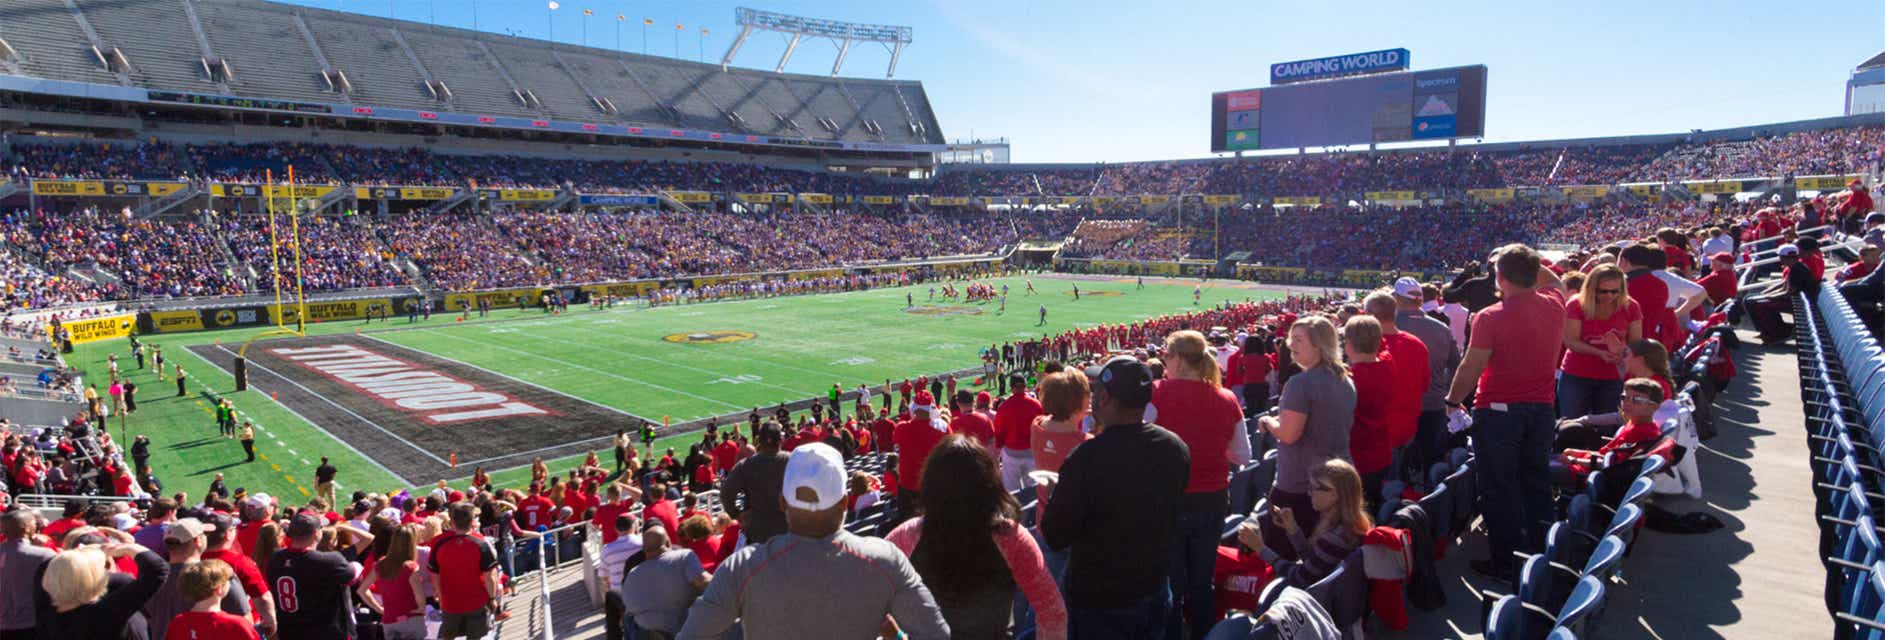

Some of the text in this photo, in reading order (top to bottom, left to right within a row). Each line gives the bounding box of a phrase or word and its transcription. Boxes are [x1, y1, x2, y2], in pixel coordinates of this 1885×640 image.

[1274, 51, 1399, 77] CAMPING WORLD
[73, 319, 116, 333] BUFFALO
[277, 575, 298, 613] 8
